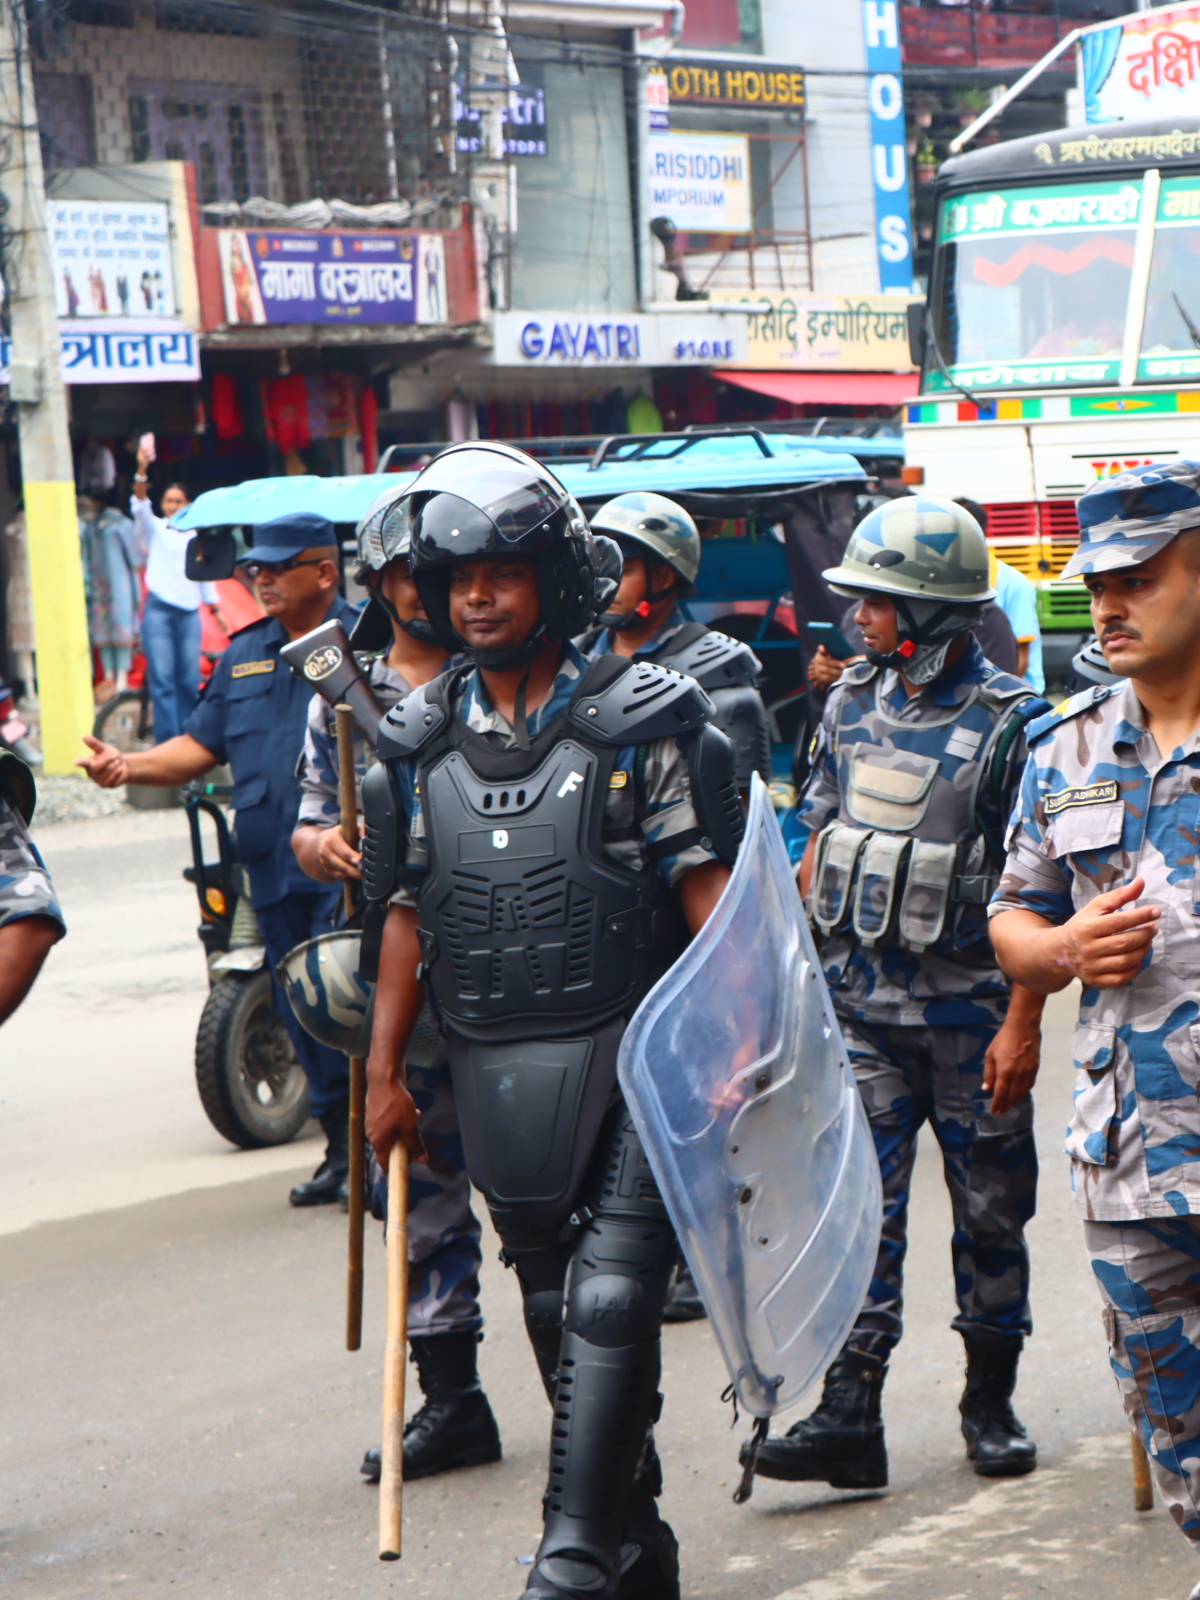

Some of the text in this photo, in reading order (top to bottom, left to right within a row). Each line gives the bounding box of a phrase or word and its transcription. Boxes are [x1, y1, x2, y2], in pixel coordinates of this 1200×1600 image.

[724, 69, 806, 105] HOUSE
[865, 1, 910, 295] HOUS
[653, 186, 726, 207] MPORIUM
[259, 261, 414, 303] मामा वस्त्रालय
[519, 320, 642, 360] GAYATRI
[1073, 786, 1114, 800] ADHIKARI
